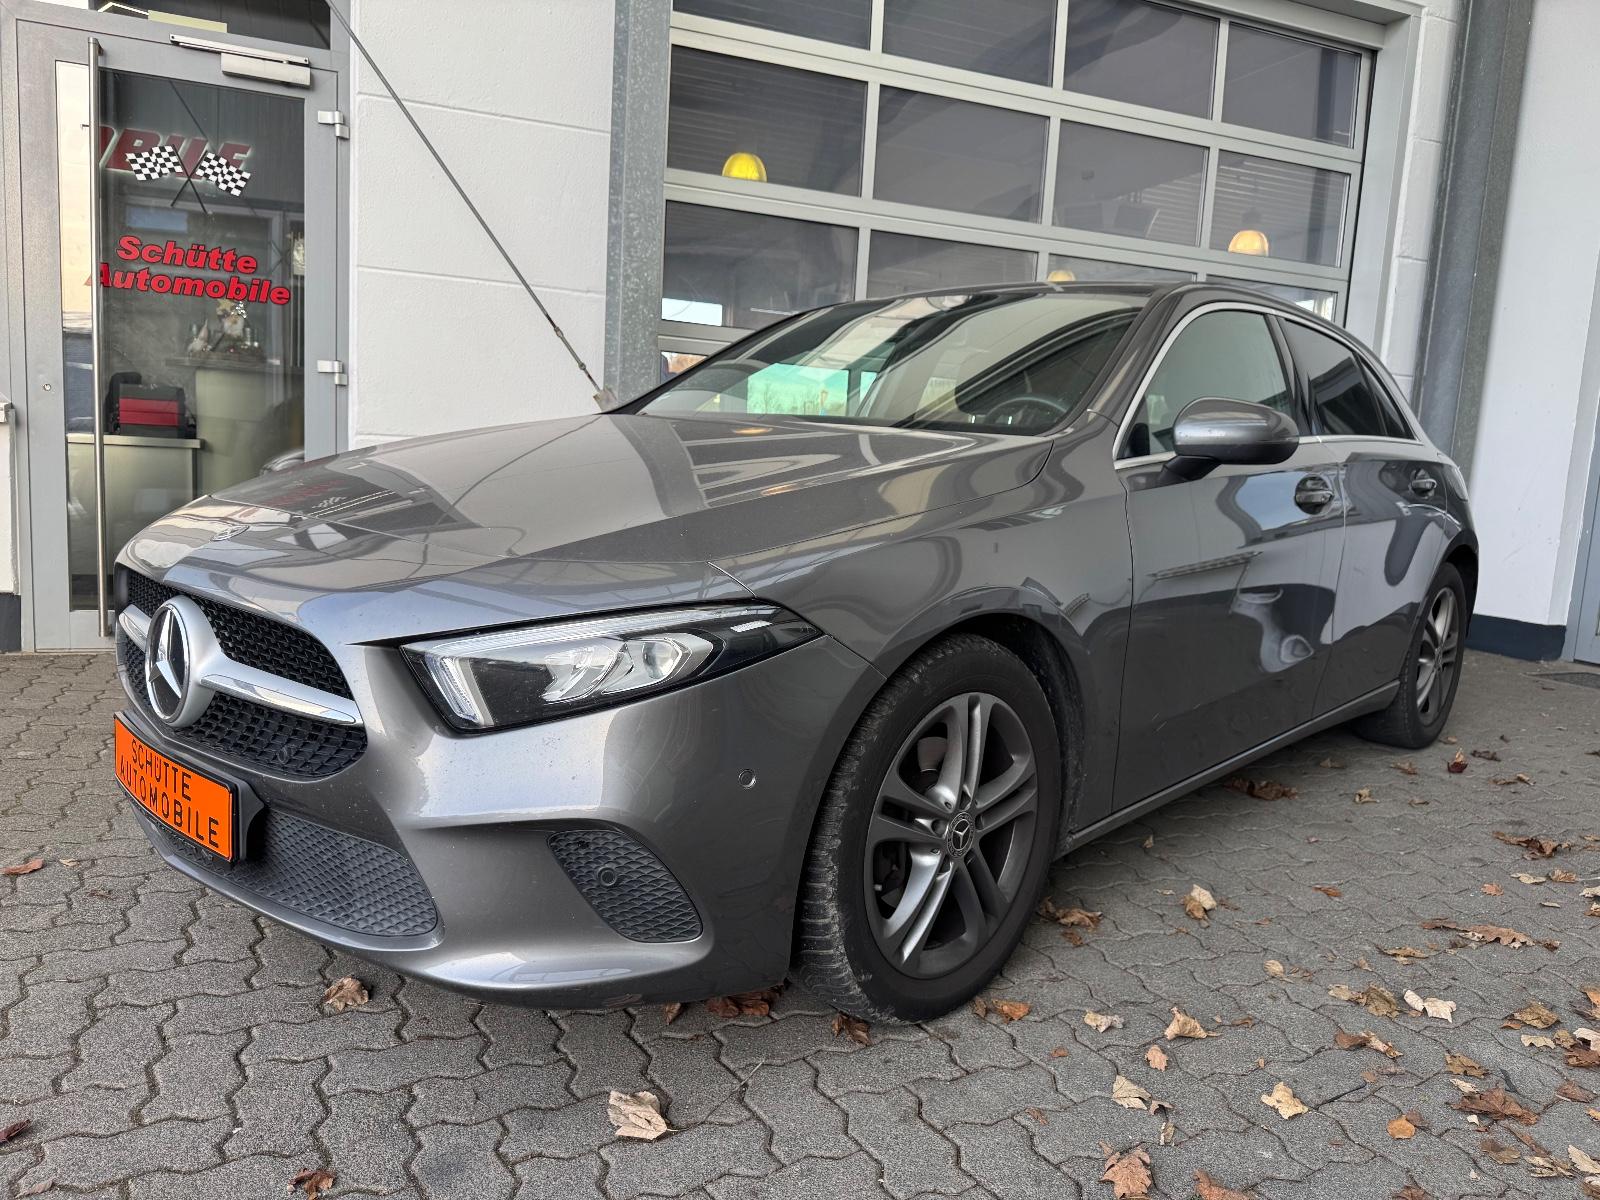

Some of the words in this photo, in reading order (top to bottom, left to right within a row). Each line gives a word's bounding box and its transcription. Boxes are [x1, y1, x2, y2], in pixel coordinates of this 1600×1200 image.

[117, 235, 257, 275] Schütte
[85, 262, 291, 305] Automobile
[131, 739, 192, 802] SCHÜTTE
[120, 755, 219, 849] AUTOMOBILE
